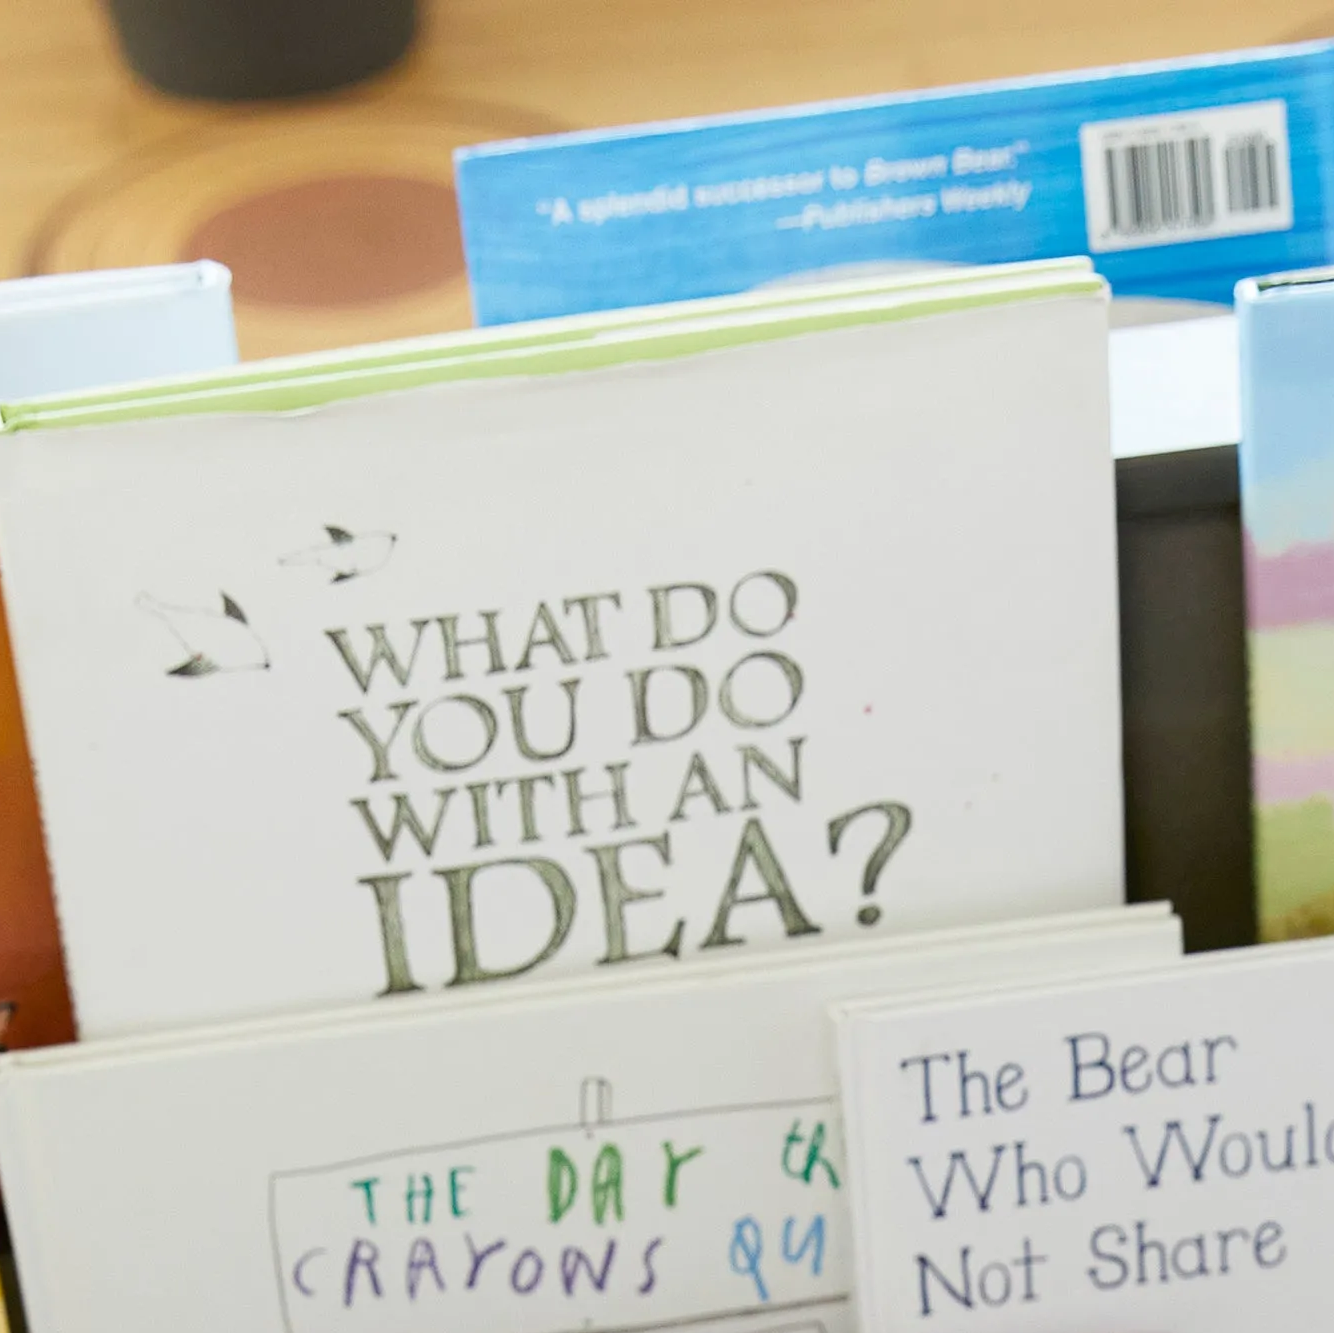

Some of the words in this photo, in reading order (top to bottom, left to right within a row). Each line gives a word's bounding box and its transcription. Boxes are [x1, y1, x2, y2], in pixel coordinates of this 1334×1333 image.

[323, 592, 623, 695] WHAT
[646, 569, 800, 653] DO
[336, 677, 582, 784] YOU
[624, 649, 806, 746] DO
[349, 760, 637, 863] WITH
[668, 735, 809, 824] AN
[356, 801, 915, 1000] IDEA?
[898, 1049, 1030, 1123] The
[1063, 1030, 1239, 1103] Bear
[349, 1165, 477, 1227] THE
[545, 1141, 706, 1227] DAY
[906, 1140, 1088, 1220] Who
[291, 1232, 664, 1308] CRAYONS
[915, 1235, 1049, 1318] Not
[1086, 1217, 1290, 1292] Share
